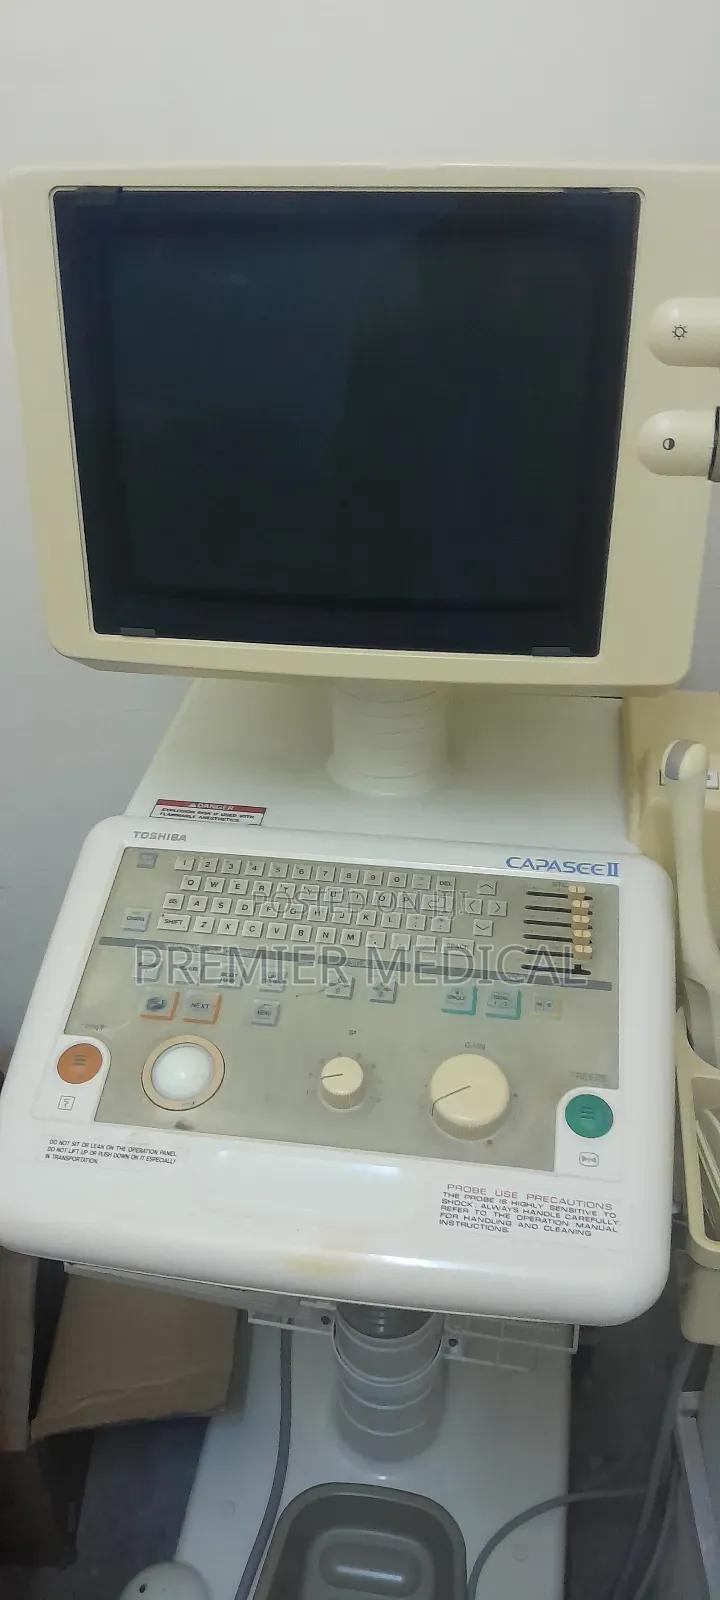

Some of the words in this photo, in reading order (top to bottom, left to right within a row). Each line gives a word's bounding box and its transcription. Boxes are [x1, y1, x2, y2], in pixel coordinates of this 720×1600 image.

[134, 831, 186, 842] TOSHIBA
[464, 1042, 486, 1050] GAIN
[146, 1156, 176, 1164] ESPECIALLY
[447, 1184, 487, 1195] PROBE
[495, 1189, 518, 1199] USE
[526, 1194, 613, 1211] PRECAUTIONS
[464, 1194, 495, 1203] PROBE
[511, 1200, 544, 1209] HIGHLY
[549, 1205, 597, 1216] SENSITIVE
[440, 1205, 469, 1213] REFER
[517, 1214, 569, 1226] OPERATION
[575, 1222, 618, 1233] MANUAL
[481, 1203, 519, 1213] ALWAYS
[523, 1208, 561, 1218] HANDLE
[463, 1215, 512, 1226] HANDLING
[543, 1225, 592, 1237] CLEANING
